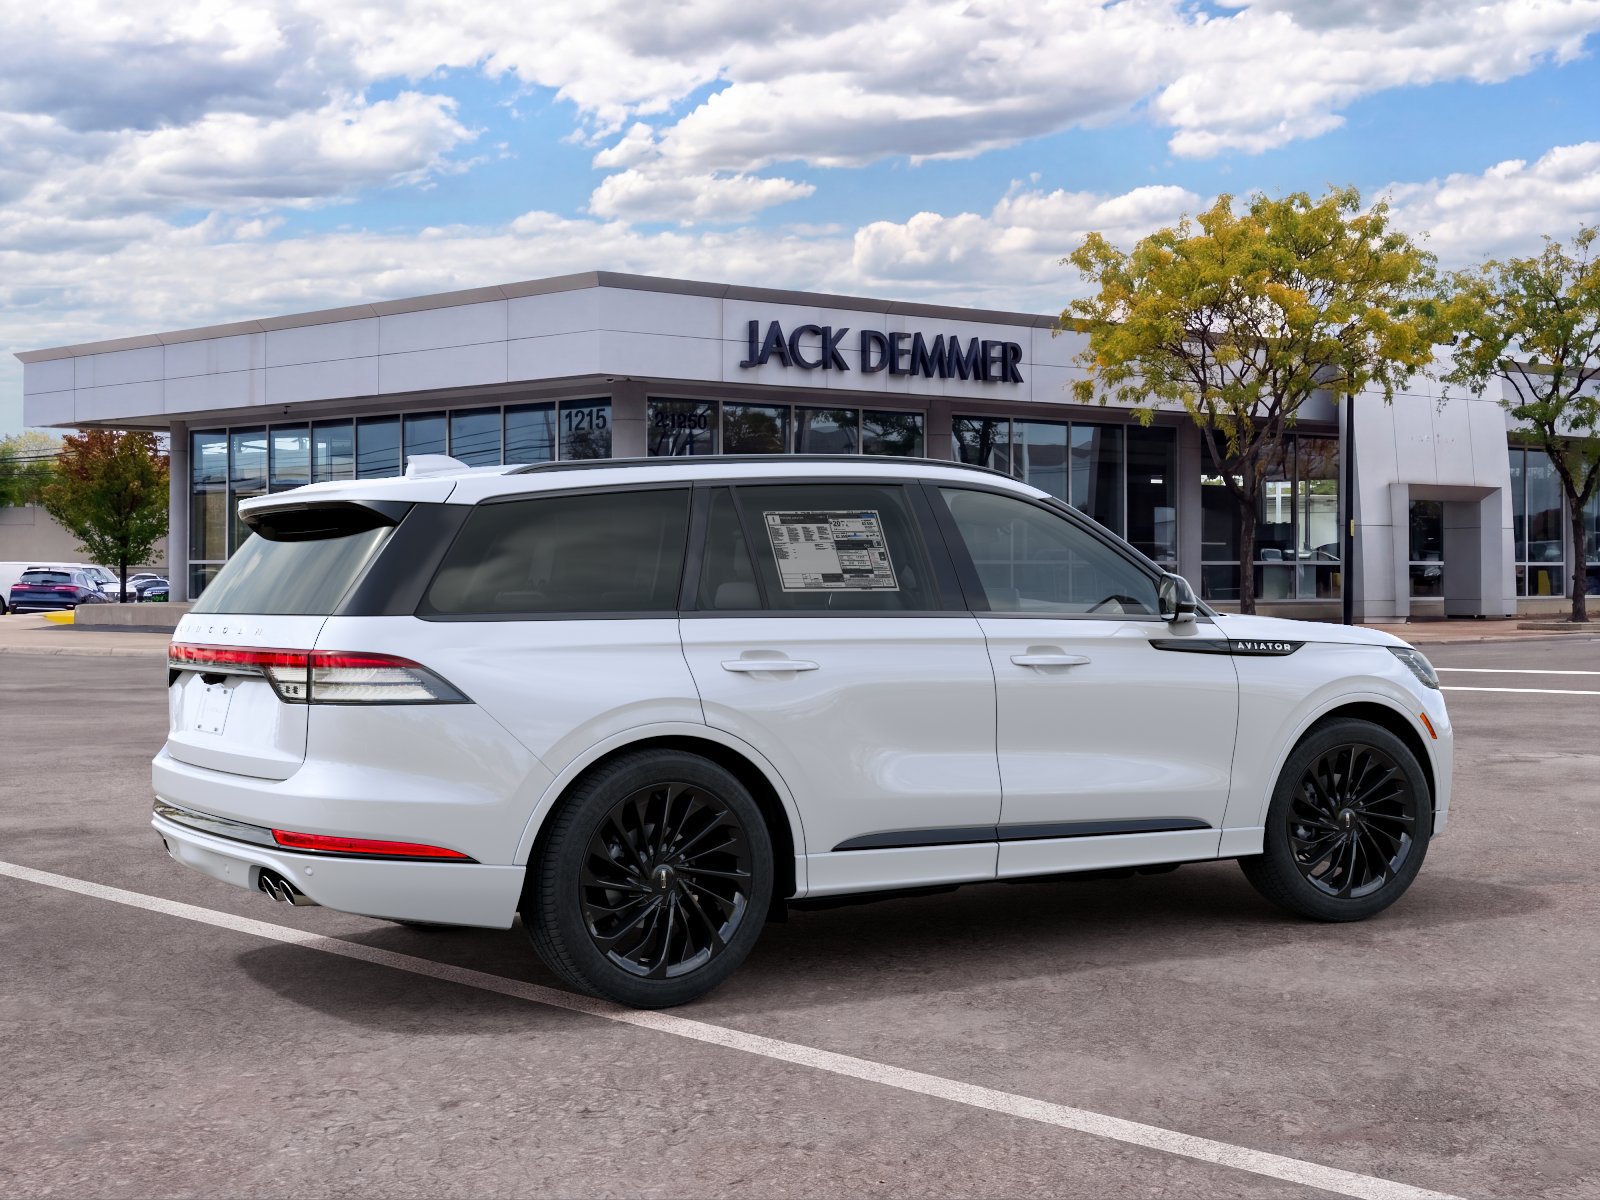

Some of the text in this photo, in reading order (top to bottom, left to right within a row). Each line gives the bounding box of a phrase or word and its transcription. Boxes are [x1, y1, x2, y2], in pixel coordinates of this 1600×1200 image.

[740, 320, 1024, 383] JACK DEMMER
[565, 408, 607, 432] 1215
[1237, 641, 1291, 651] AVIATOR
